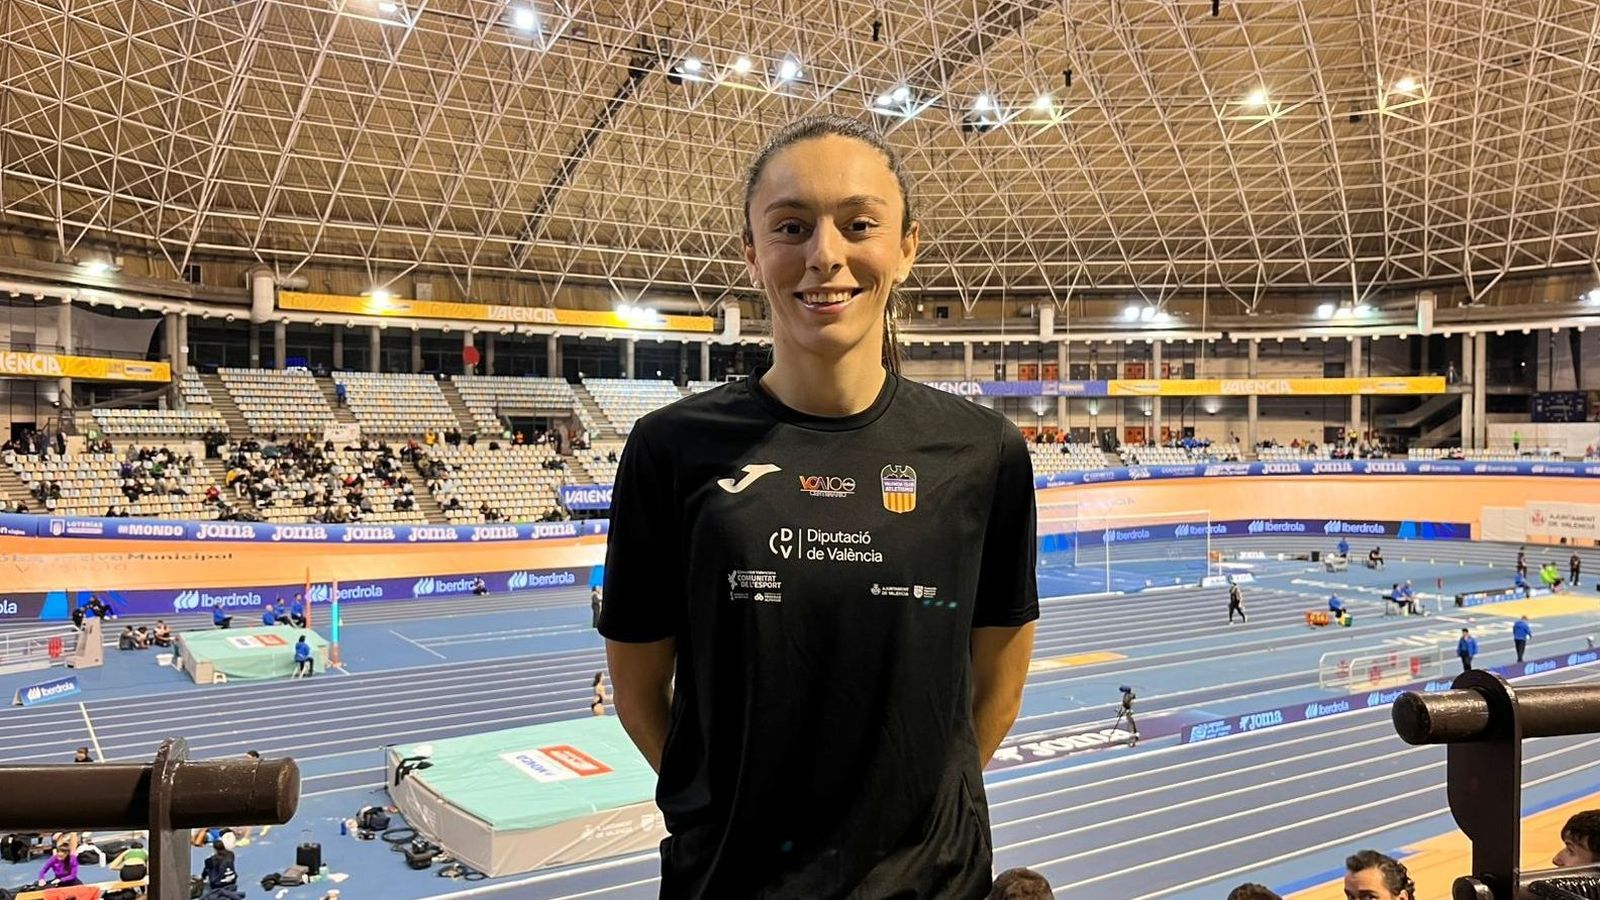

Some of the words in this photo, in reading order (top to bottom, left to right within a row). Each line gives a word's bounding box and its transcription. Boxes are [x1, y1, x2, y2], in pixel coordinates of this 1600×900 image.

[565, 490, 613, 503] VALENC
[129, 523, 184, 537] MONDO
[1264, 521, 1305, 532] Iberdrola
[1342, 523, 1384, 534] Iberdrola
[807, 529, 871, 546] Diputació
[807, 547, 825, 560] de
[827, 547, 883, 563] València
[436, 578, 476, 593] Iberdro
[529, 571, 575, 586] Iberdrola
[201, 591, 261, 608] Iberdrola
[41, 681, 76, 697] Iberdrola
